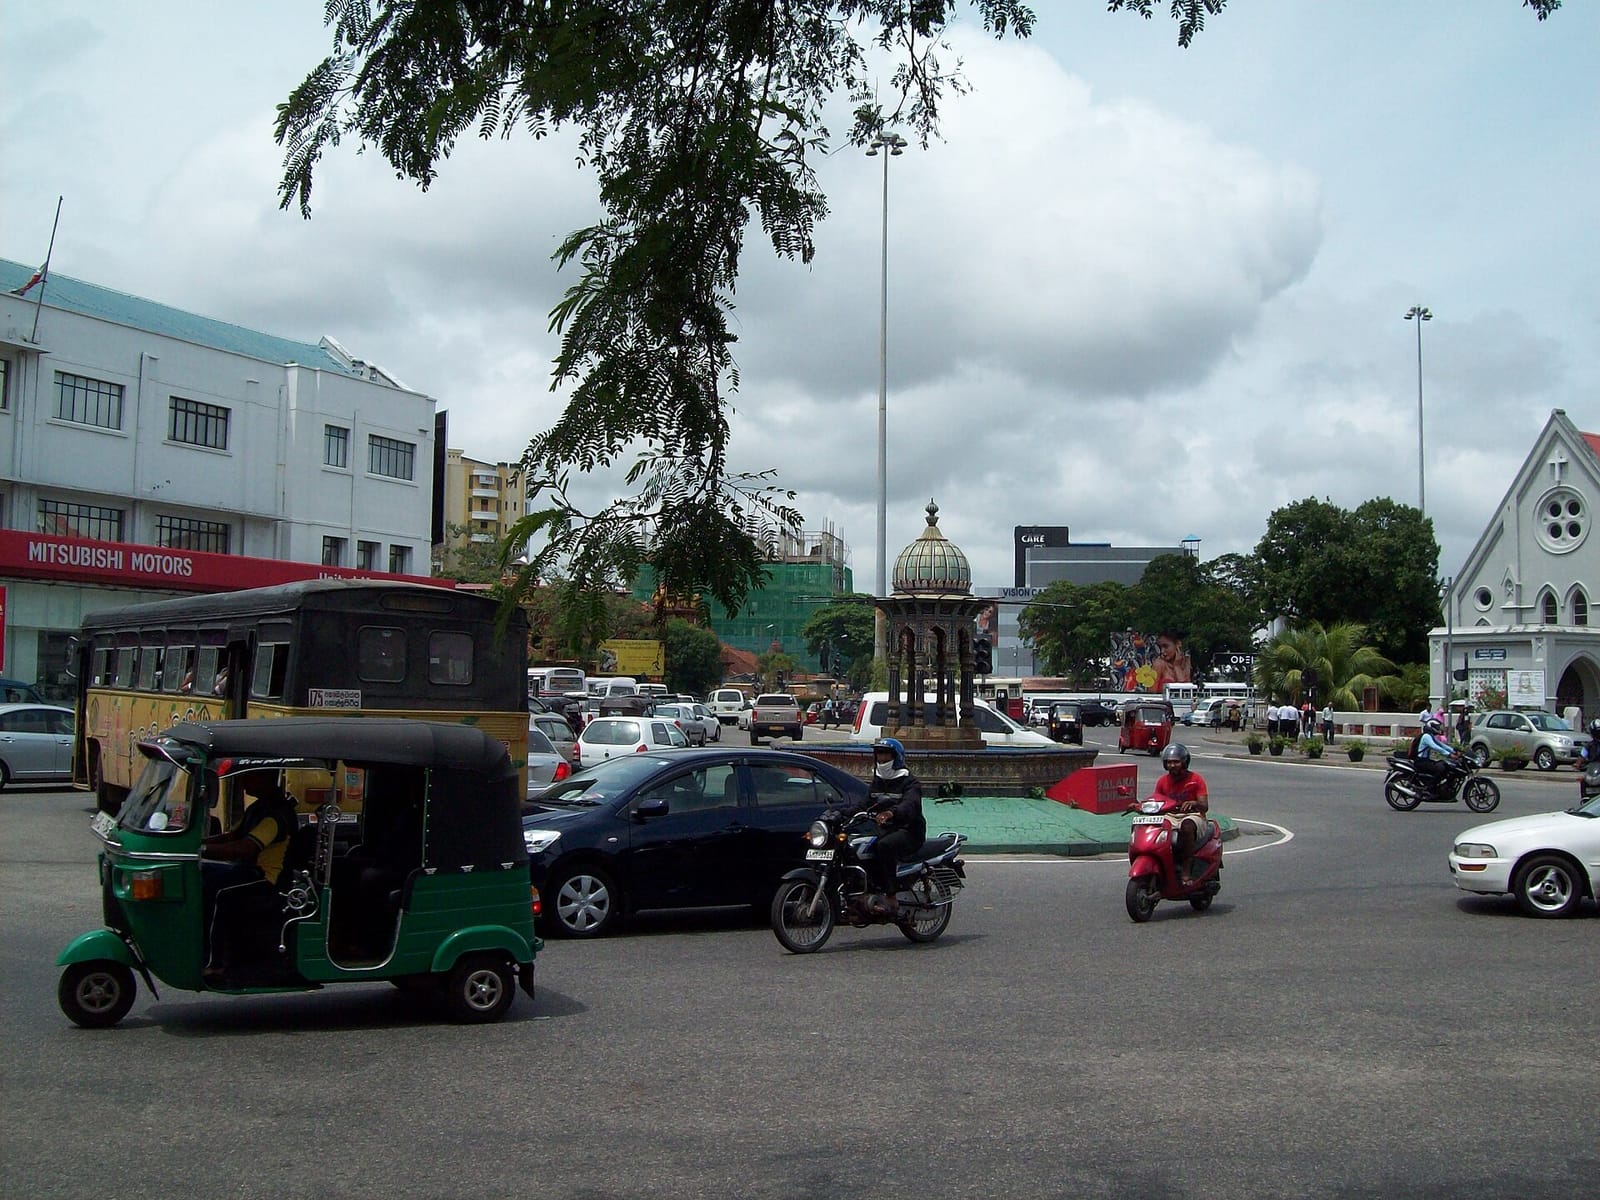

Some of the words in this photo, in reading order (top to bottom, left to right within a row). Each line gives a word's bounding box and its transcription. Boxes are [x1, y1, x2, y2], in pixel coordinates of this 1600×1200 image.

[28, 541, 123, 570] MITSUBISHI
[131, 552, 192, 577] MOTORS
[1002, 588, 1030, 597] VISION
[310, 690, 324, 706] 175
